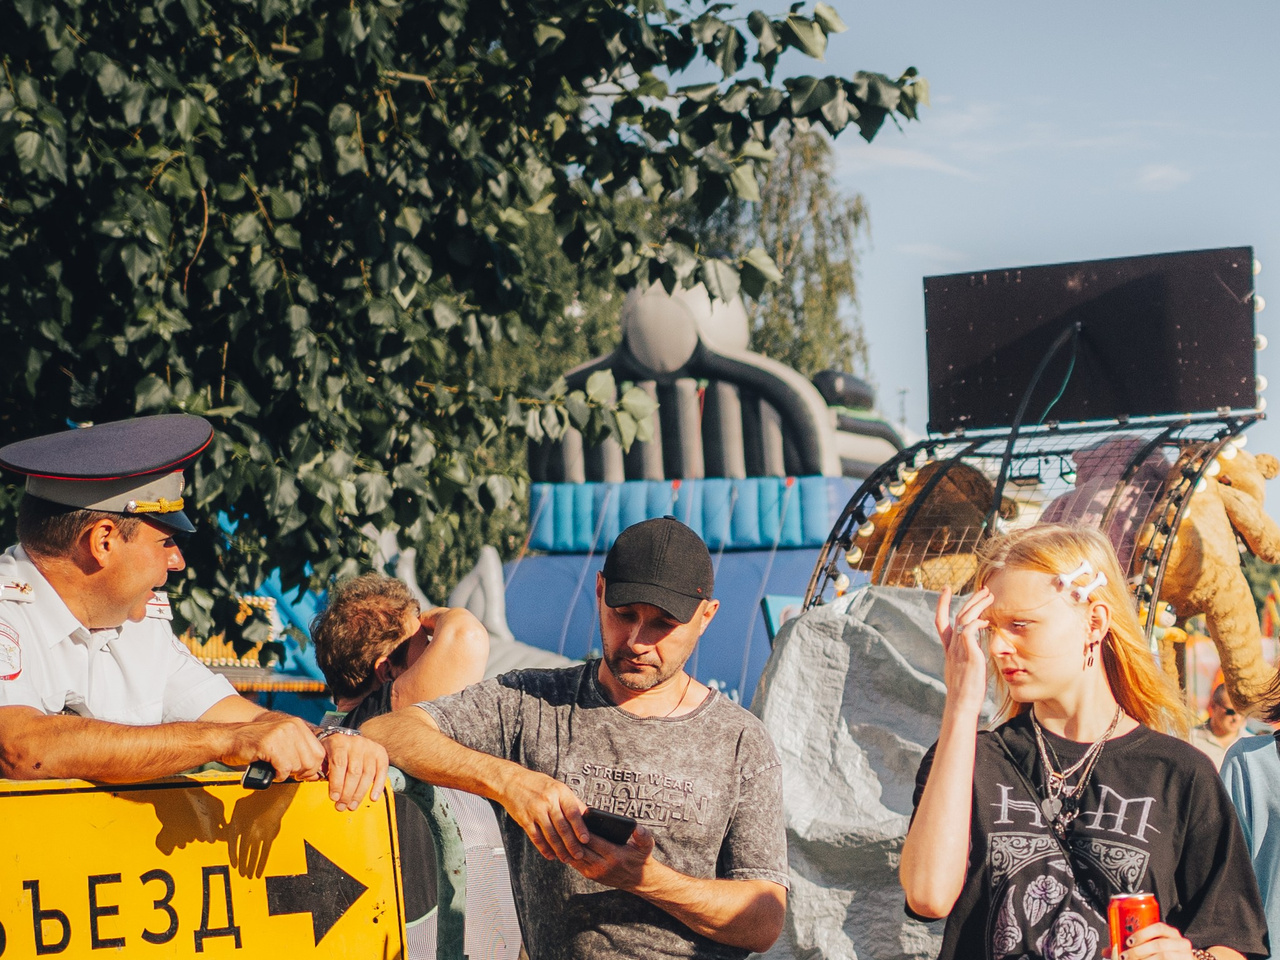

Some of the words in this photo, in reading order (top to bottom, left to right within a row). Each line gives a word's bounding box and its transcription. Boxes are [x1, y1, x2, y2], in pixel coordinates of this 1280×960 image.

[582, 763, 642, 783] STREET
[649, 772, 693, 792] WEAR
[0, 865, 243, 957] ЪЕЗД
